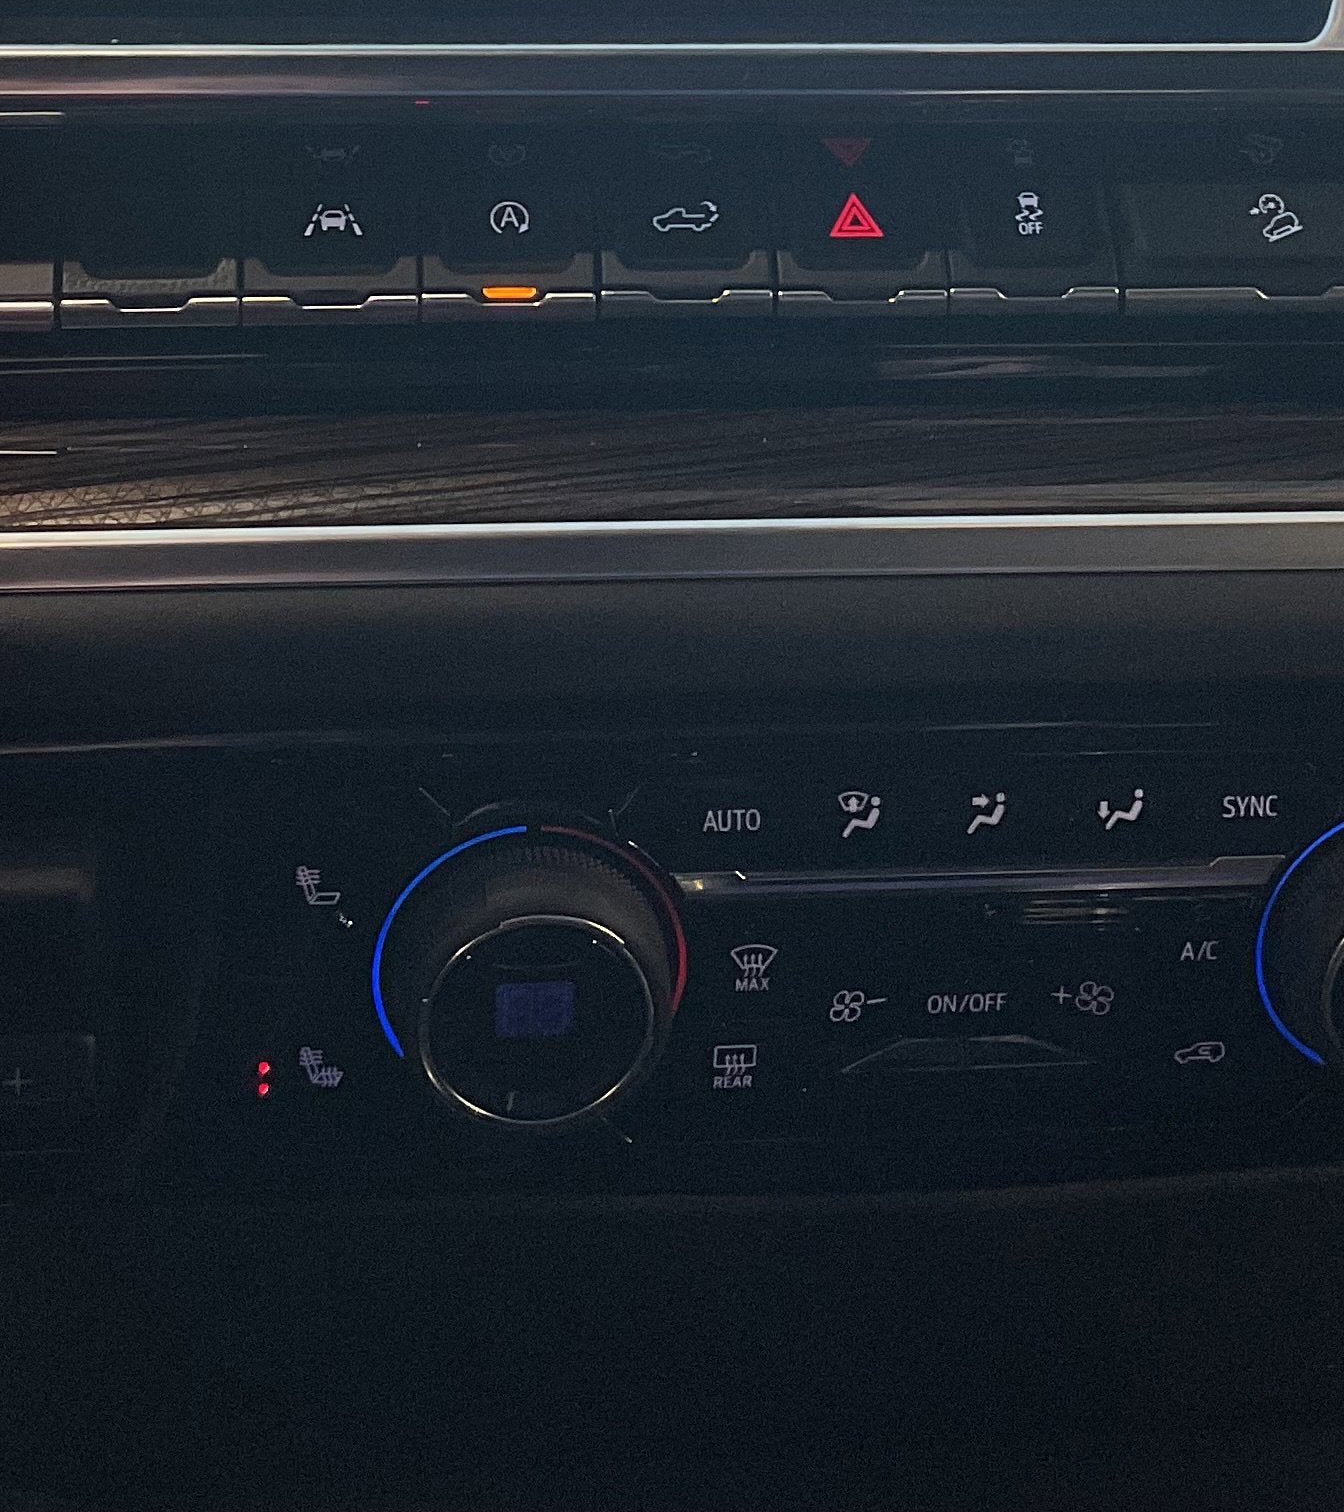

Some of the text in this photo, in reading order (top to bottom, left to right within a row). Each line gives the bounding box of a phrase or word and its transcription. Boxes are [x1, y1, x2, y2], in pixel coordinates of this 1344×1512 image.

[500, 206, 520, 228] A
[1018, 221, 1044, 235] OFF
[1221, 795, 1279, 819] SYNC
[702, 809, 762, 833] AUTO
[1179, 941, 1220, 962] A/C
[735, 977, 770, 992] MAX
[926, 993, 1008, 1014] ON/OFF
[712, 1075, 753, 1089] REAR
